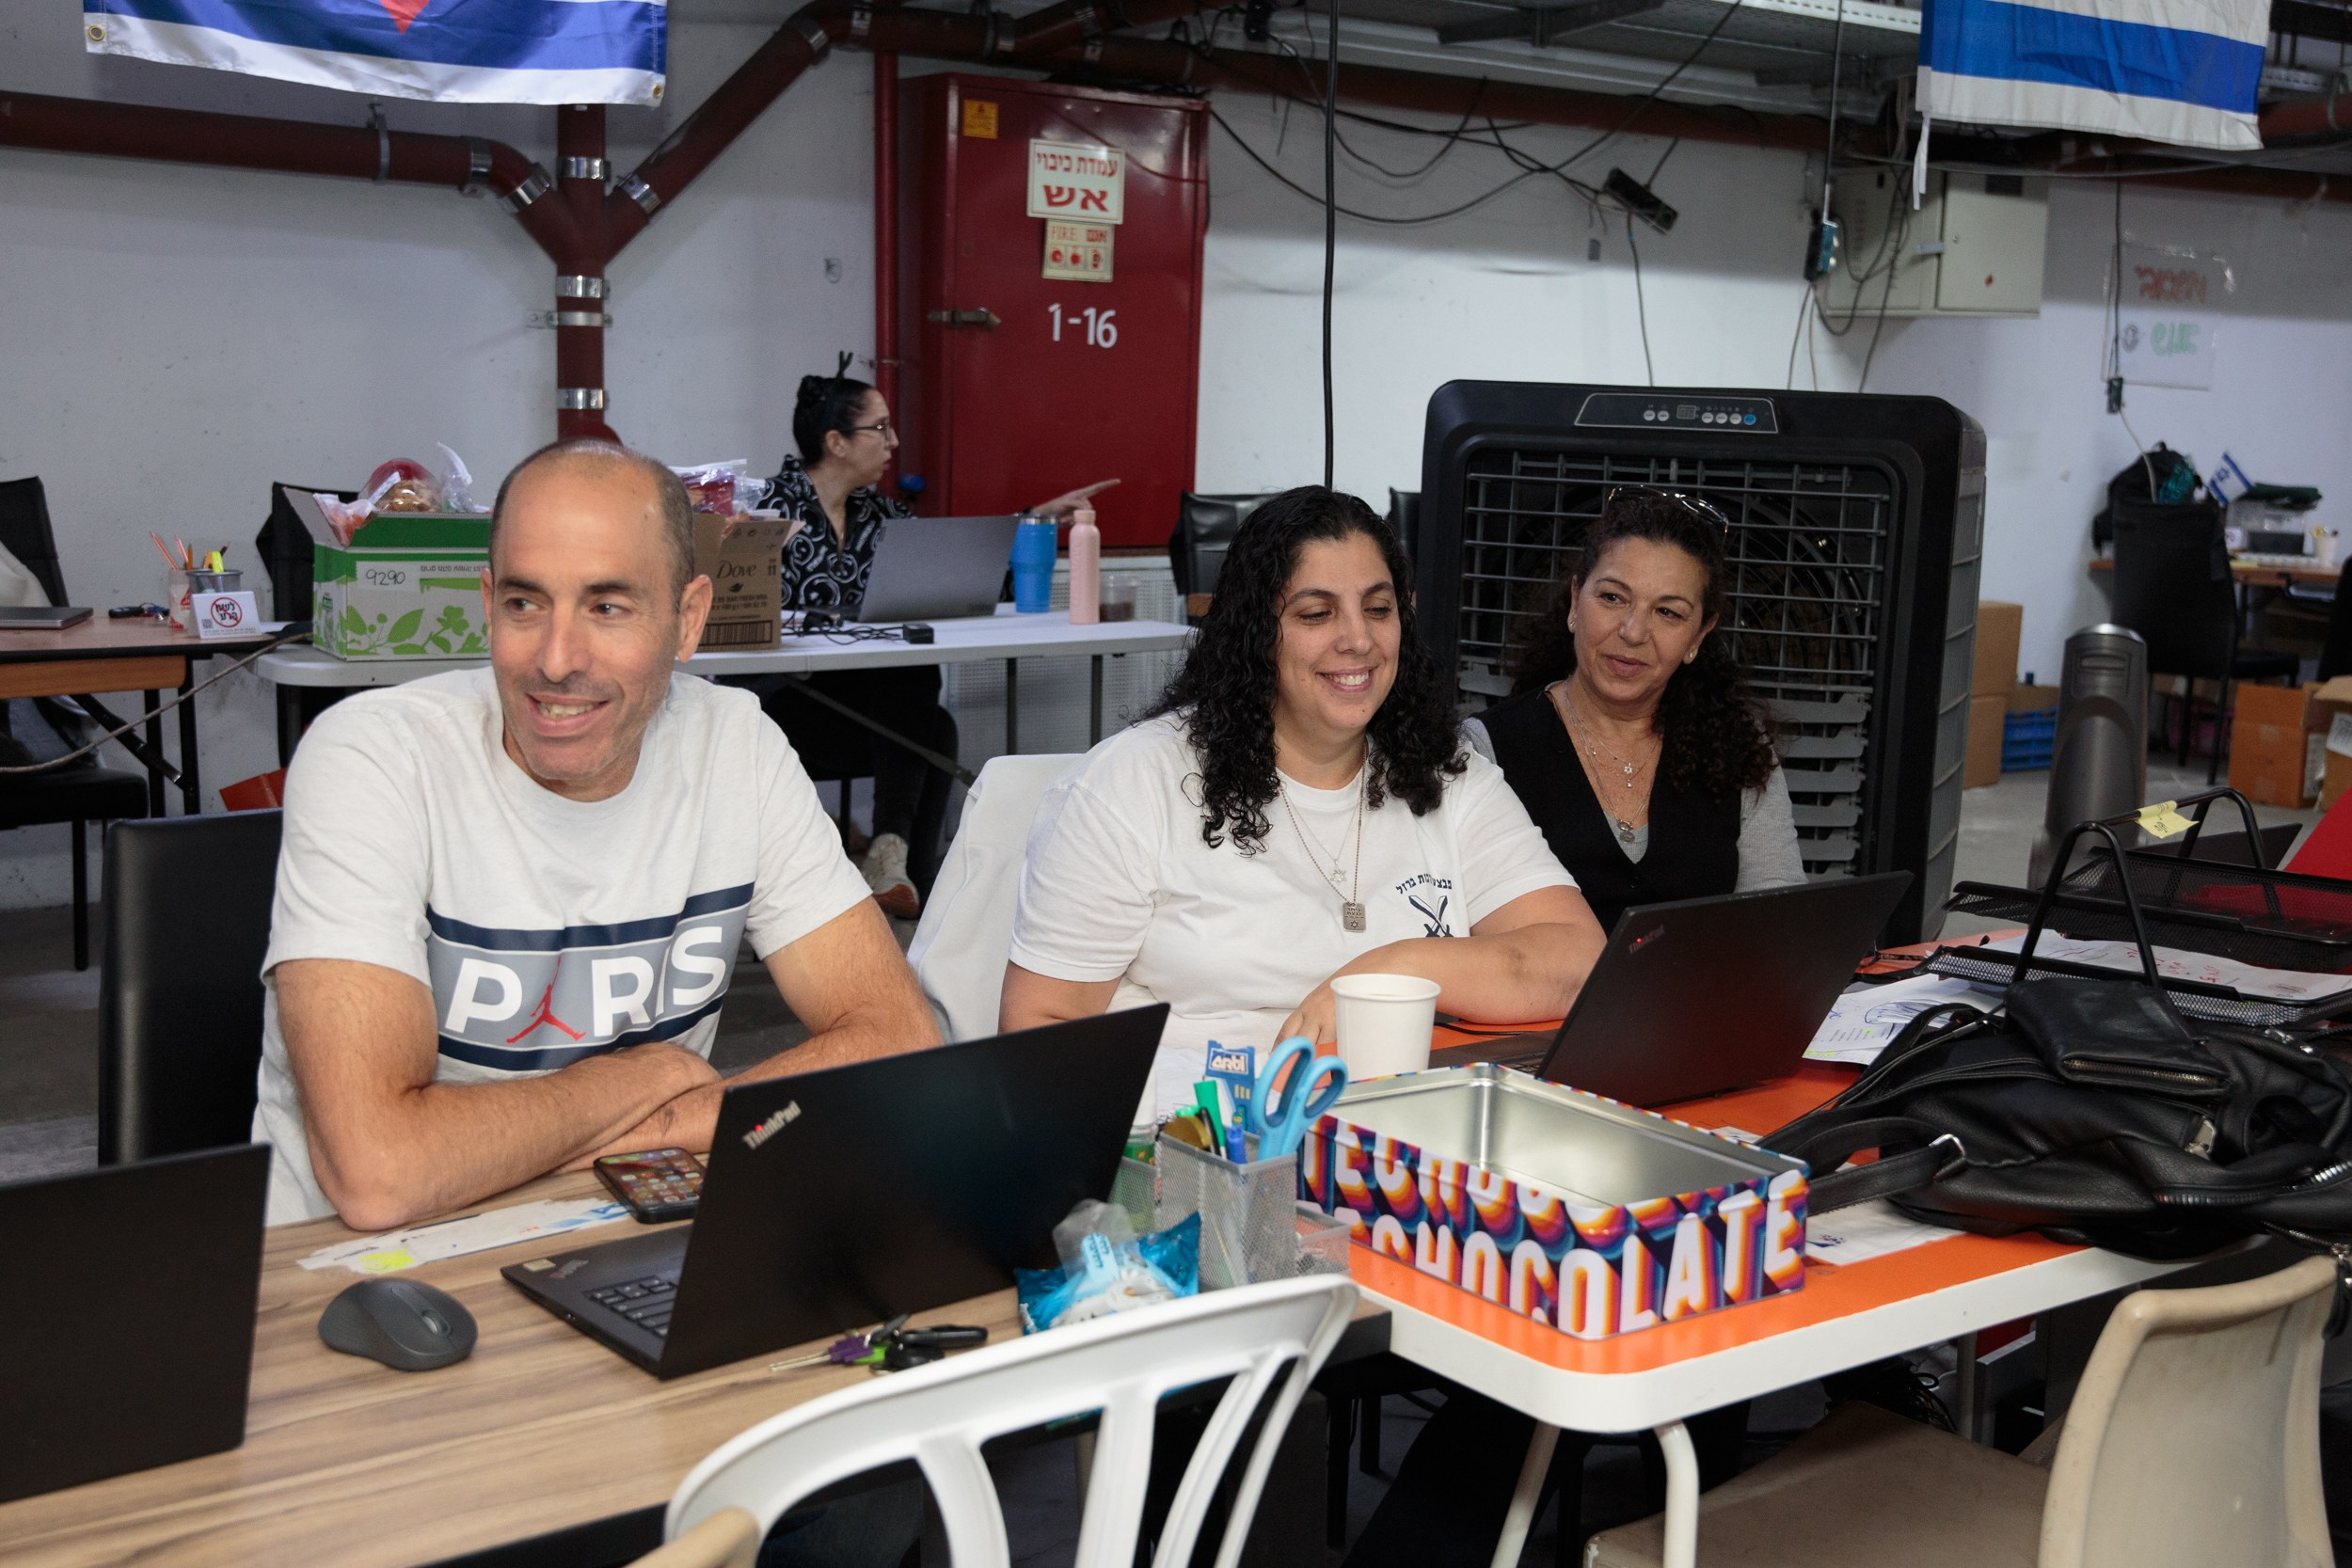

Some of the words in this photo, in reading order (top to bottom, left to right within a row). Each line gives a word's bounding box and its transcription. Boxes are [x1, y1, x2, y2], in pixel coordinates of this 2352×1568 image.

[1037, 152, 1072, 172] כיבוי
[1076, 156, 1118, 178] עמדת
[1043, 184, 1108, 212] אש
[1048, 302, 1118, 348] 1-16
[366, 568, 405, 586] 9290
[716, 560, 757, 579] Dove
[445, 926, 726, 1037] PRIS
[741, 1100, 802, 1149] ThinkPad
